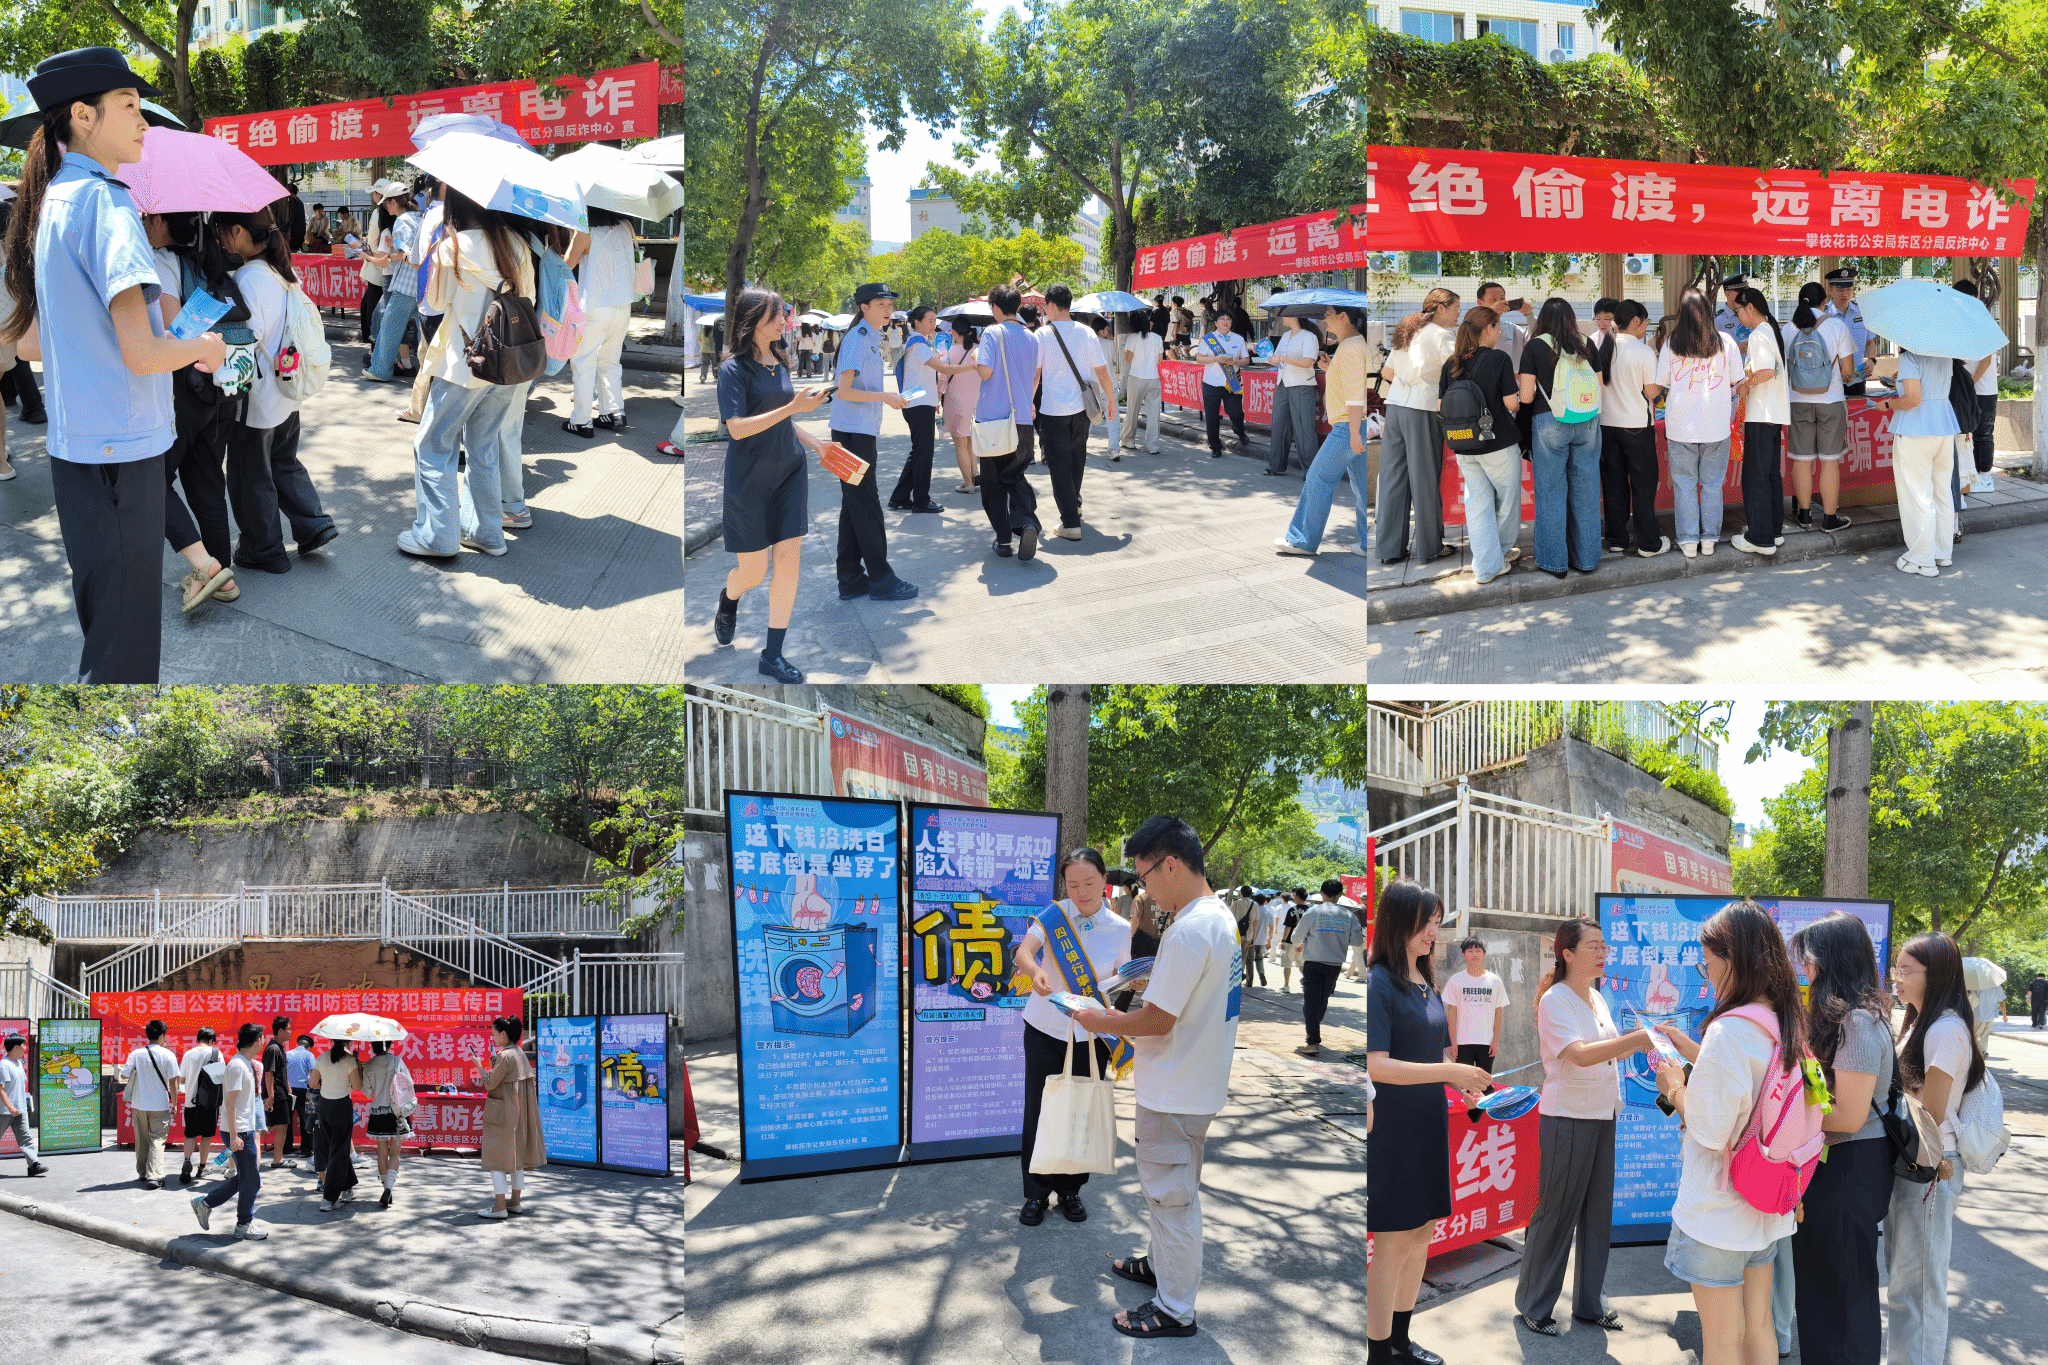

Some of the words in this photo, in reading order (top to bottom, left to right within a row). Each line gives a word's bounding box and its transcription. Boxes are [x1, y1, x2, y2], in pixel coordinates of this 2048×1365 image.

[622, 120, 635, 132] 宣
[1995, 236, 2007, 251] 宣
[1249, 379, 1276, 413] 防范
[903, 751, 972, 797] 国家奖学金
[745, 823, 885, 852] 这下钱没洗白
[916, 829, 1052, 859] 人生事业再成功
[734, 851, 895, 879] 牢底倒是坐穿了
[915, 852, 1050, 881] 陷入传销一场空
[1664, 851, 1720, 888] 国家奖学金
[1462, 987, 1493, 996] FREEDOM
[1455, 1123, 1516, 1201] 线
[1429, 1208, 1487, 1245] 区分局
[1497, 1200, 1515, 1225] 宣
